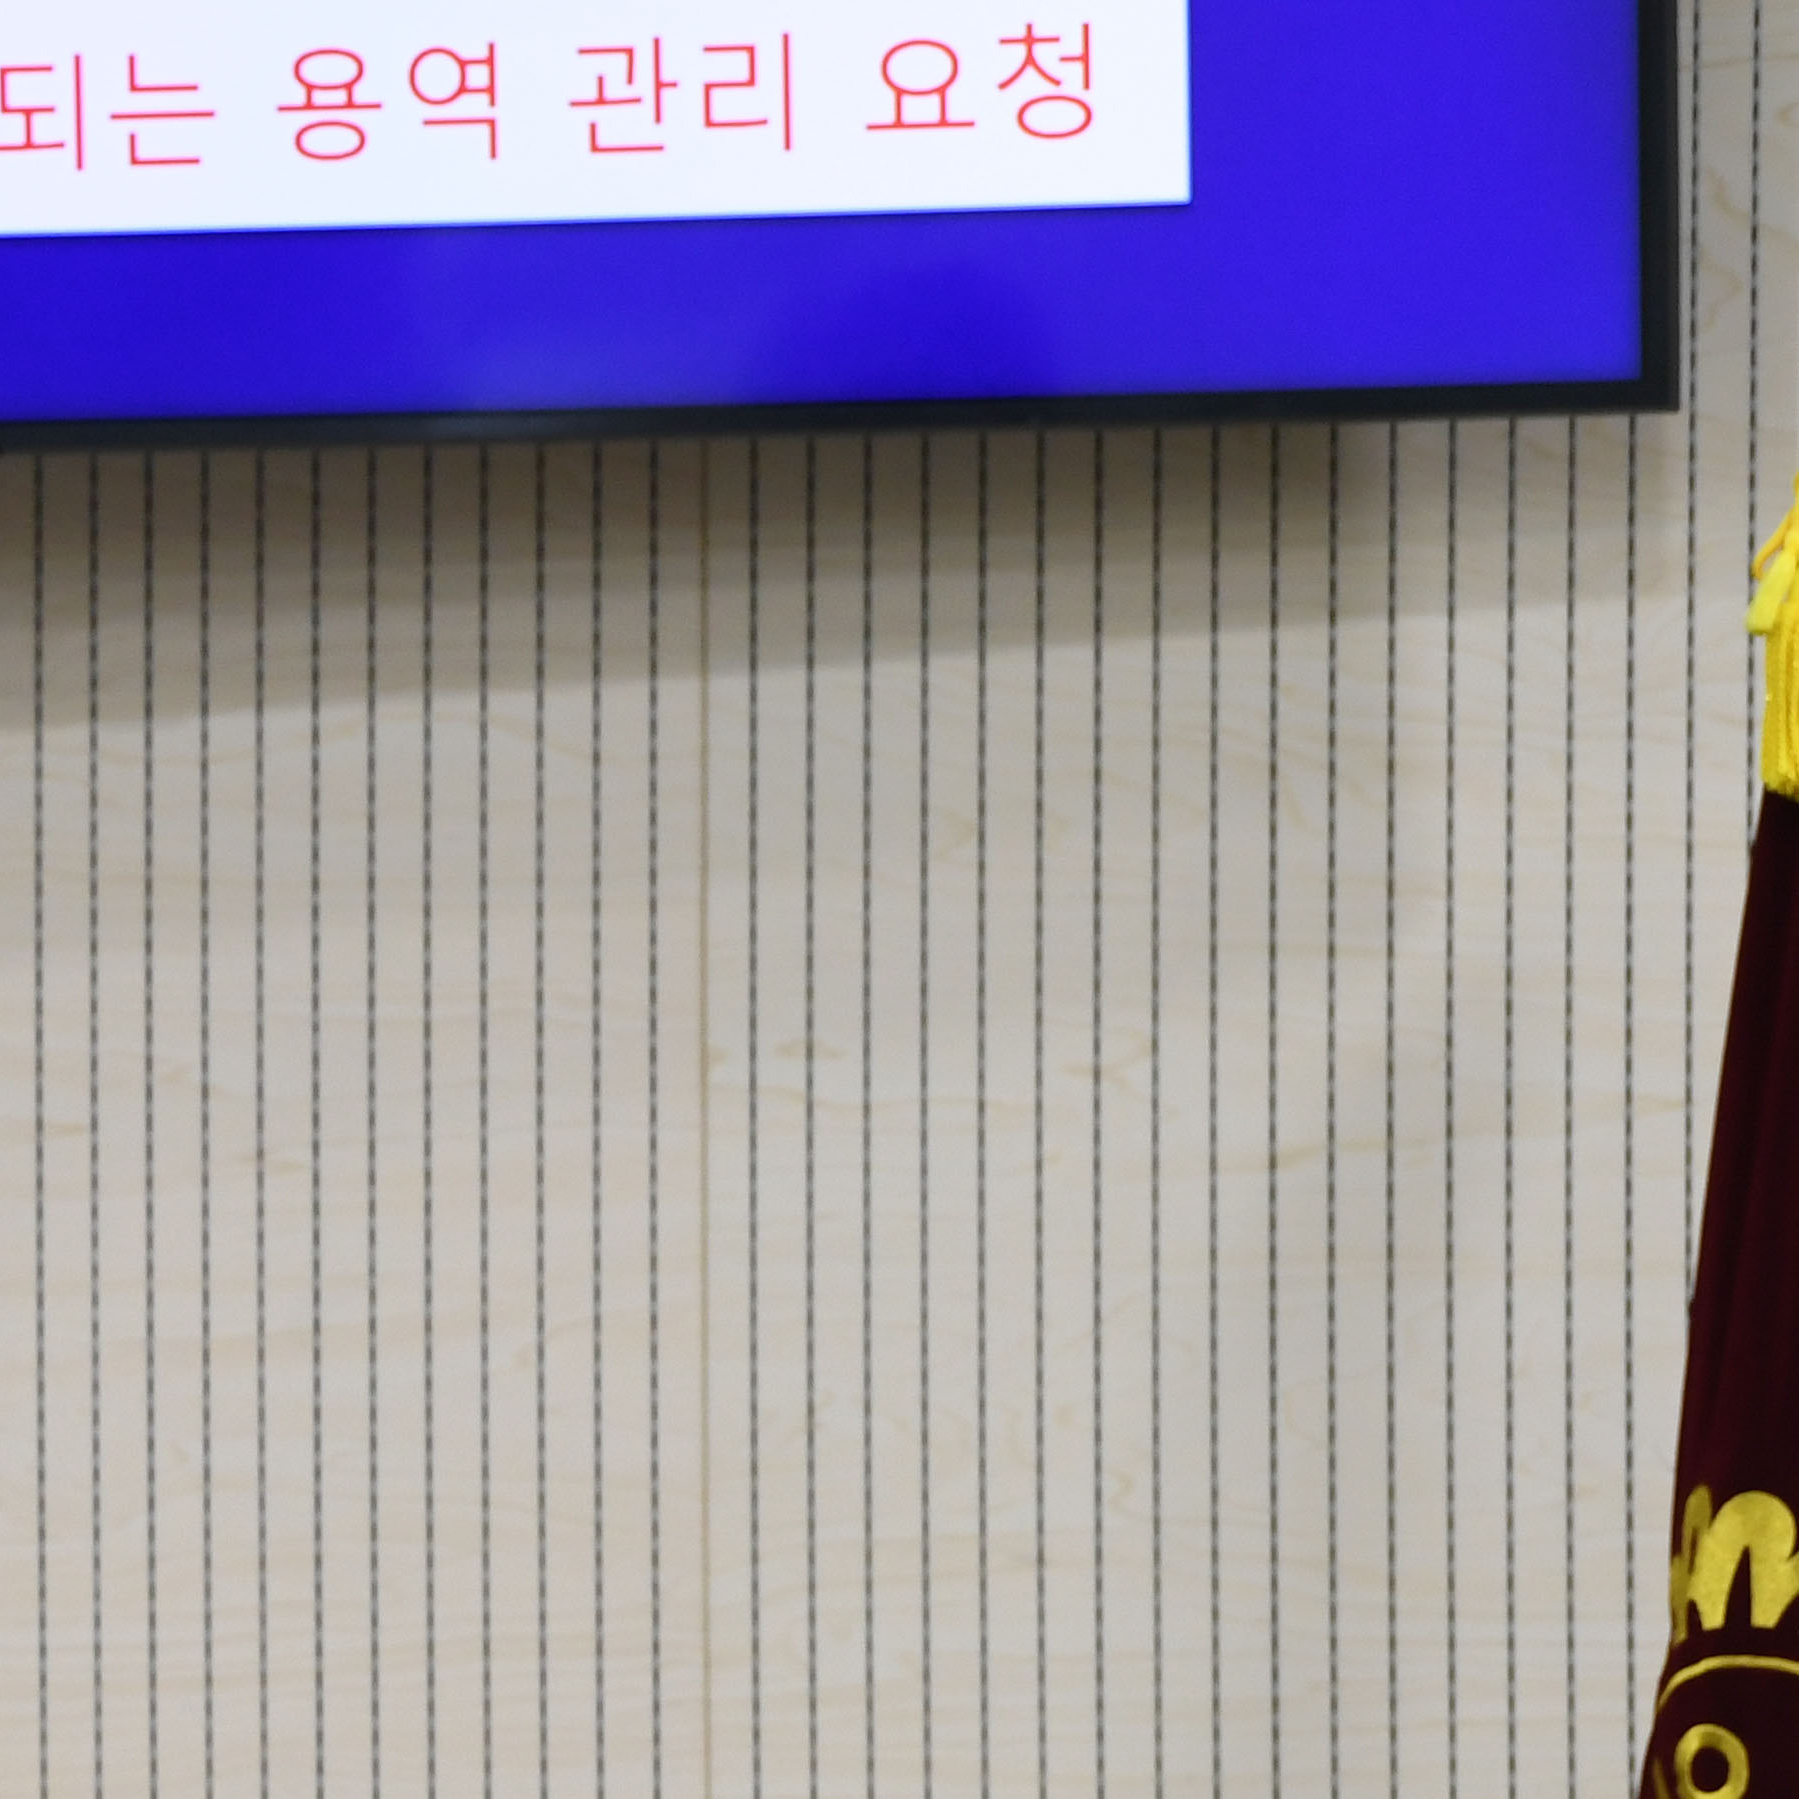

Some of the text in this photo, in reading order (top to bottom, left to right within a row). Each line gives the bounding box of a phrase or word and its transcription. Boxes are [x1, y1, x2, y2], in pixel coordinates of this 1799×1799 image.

[275, 40, 500, 164] 용역
[568, 30, 795, 156] 관리
[865, 20, 1095, 142] 요청
